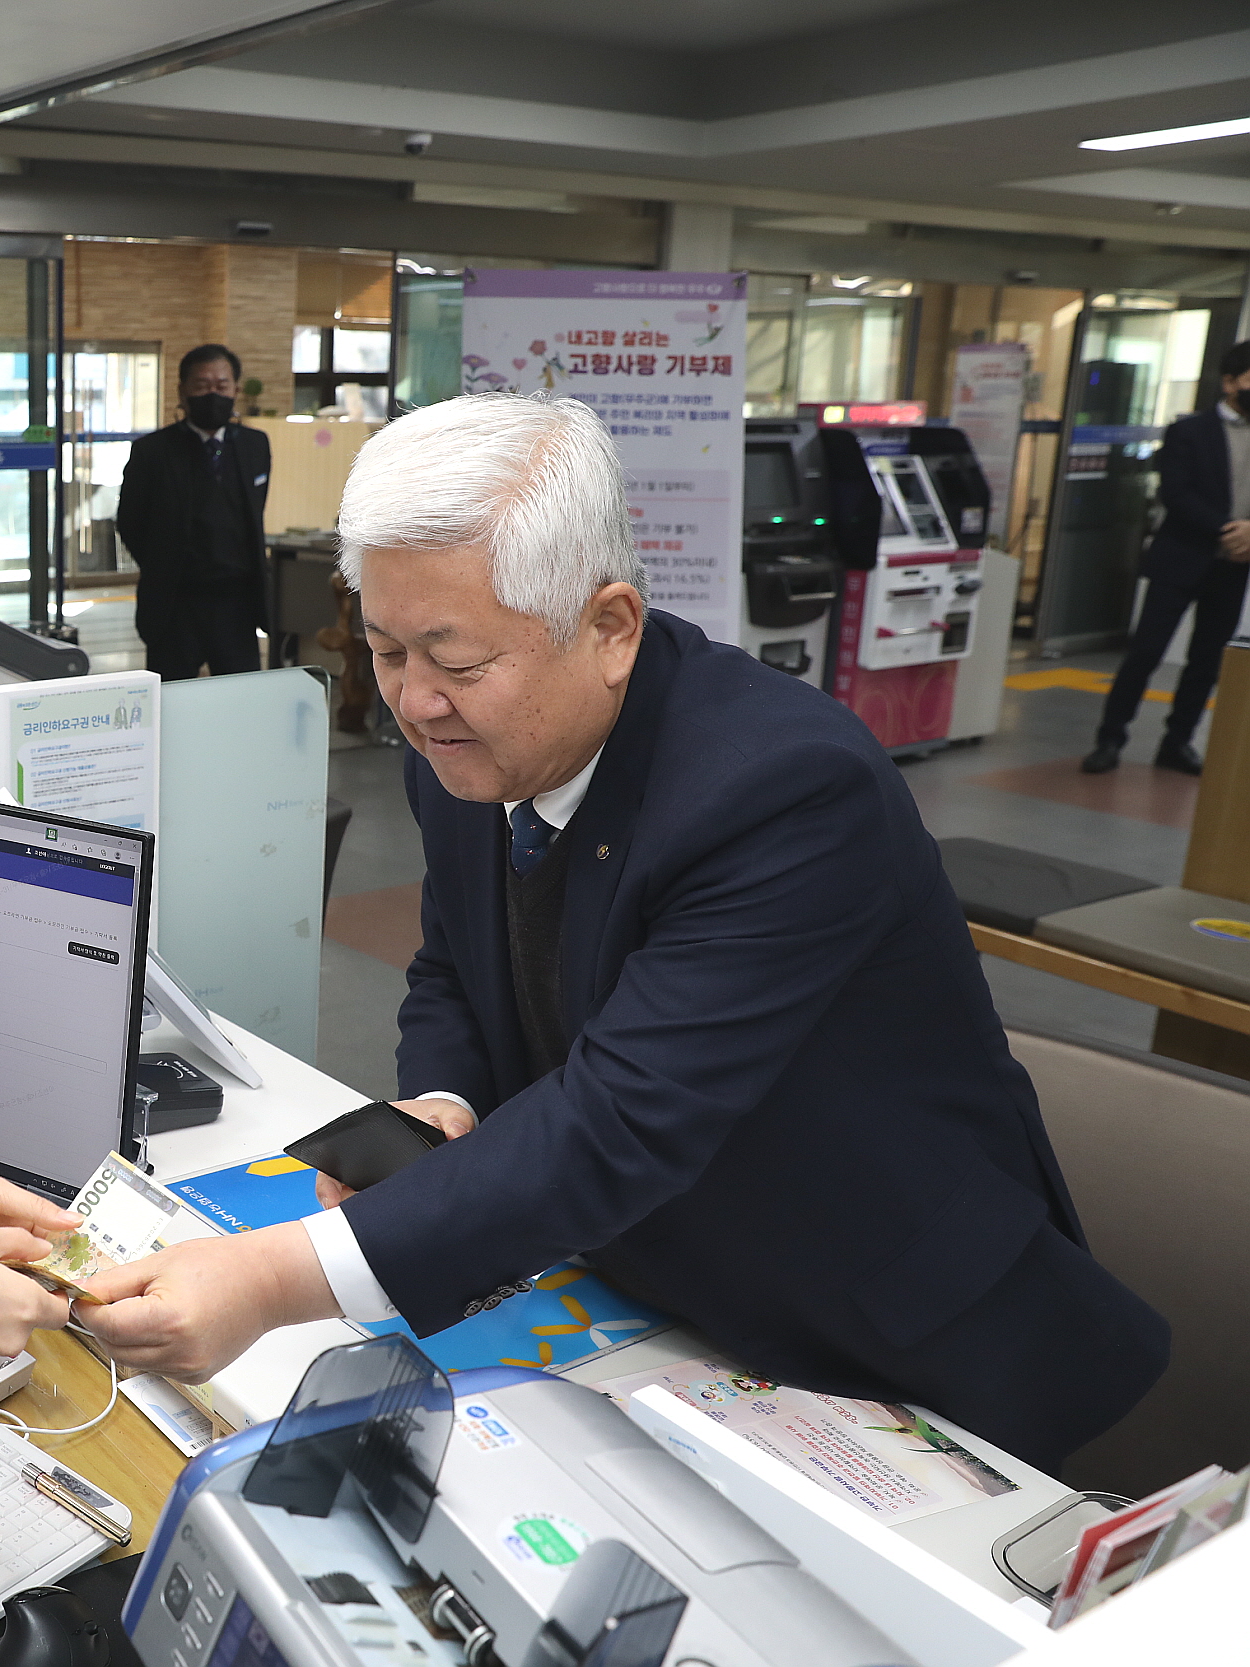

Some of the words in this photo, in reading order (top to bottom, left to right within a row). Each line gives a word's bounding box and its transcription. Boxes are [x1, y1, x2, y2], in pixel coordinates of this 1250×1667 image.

[568, 330, 617, 347] 내고향
[622, 331, 670, 347] 살리는
[568, 353, 658, 376] 고향사랑
[665, 354, 732, 377] 기부제
[23, 715, 90, 736] 금리인하요구권
[91, 714, 110, 728] 안내
[76, 1167, 119, 1218] 5000
[180, 1185, 242, 1228] NH농협은행
[831, 1475, 864, 1496] 고향사랑
